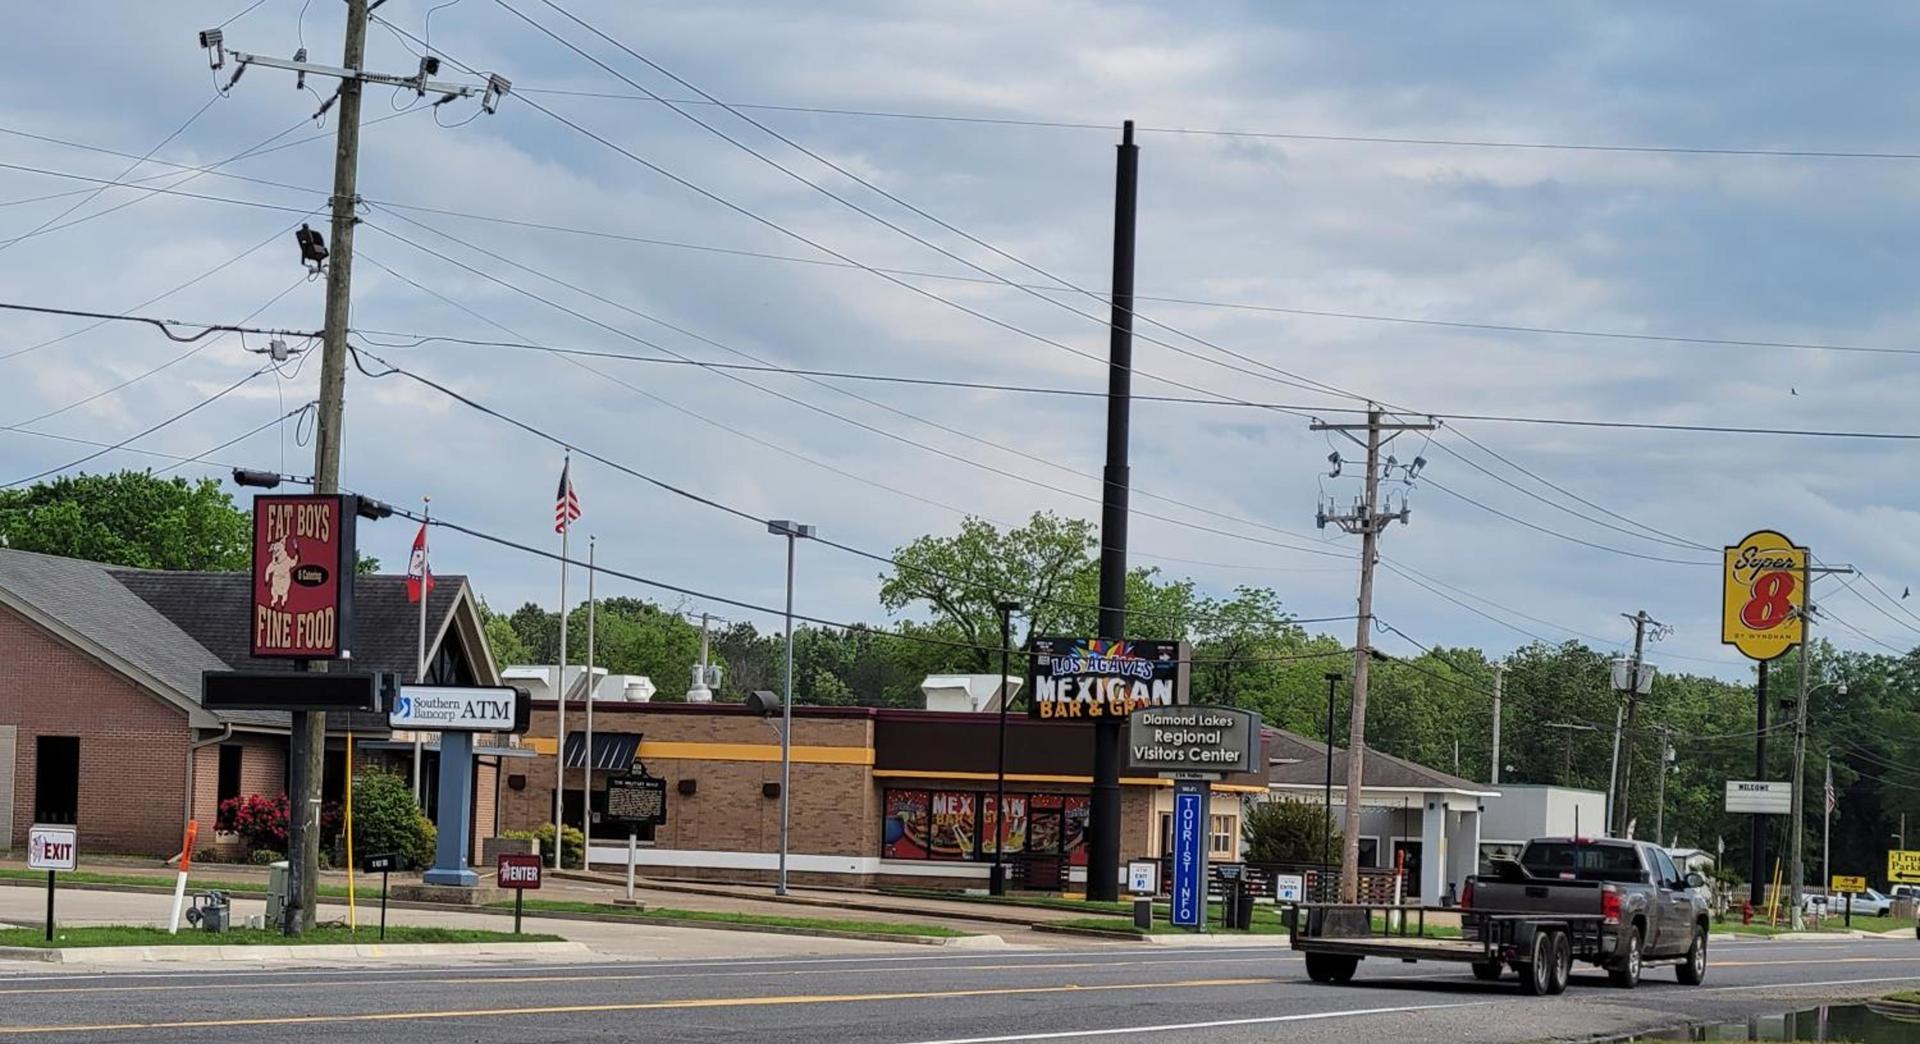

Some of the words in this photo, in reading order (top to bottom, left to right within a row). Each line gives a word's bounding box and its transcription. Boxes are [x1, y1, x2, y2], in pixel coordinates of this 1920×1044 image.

[267, 504, 293, 543] FAT
[297, 503, 330, 543] BOYS
[1734, 546, 1797, 580] Super
[302, 569, 322, 583] Catering
[1740, 570, 1796, 630] 8
[256, 604, 292, 649] FINE
[296, 606, 334, 649] FOOD
[1051, 658, 1081, 676] LOS
[1086, 656, 1154, 679] AGAVES
[1035, 675, 1173, 706] MEXICAN
[413, 697, 460, 709] Southern
[460, 700, 511, 720] ATM
[1040, 701, 1081, 718] BAR
[1088, 701, 1103, 717] &
[414, 709, 456, 722] Bancorp
[1143, 713, 1196, 726] Diamond
[1199, 714, 1233, 727] Lakes
[1154, 729, 1221, 746] Regional
[1133, 746, 1185, 760] Visitors
[1188, 748, 1241, 762] Center
[1183, 798, 1194, 872] TOURIST
[44, 842, 72, 860] EXIT
[511, 866, 538, 880] ENTER
[1180, 877, 1191, 919] INFO
